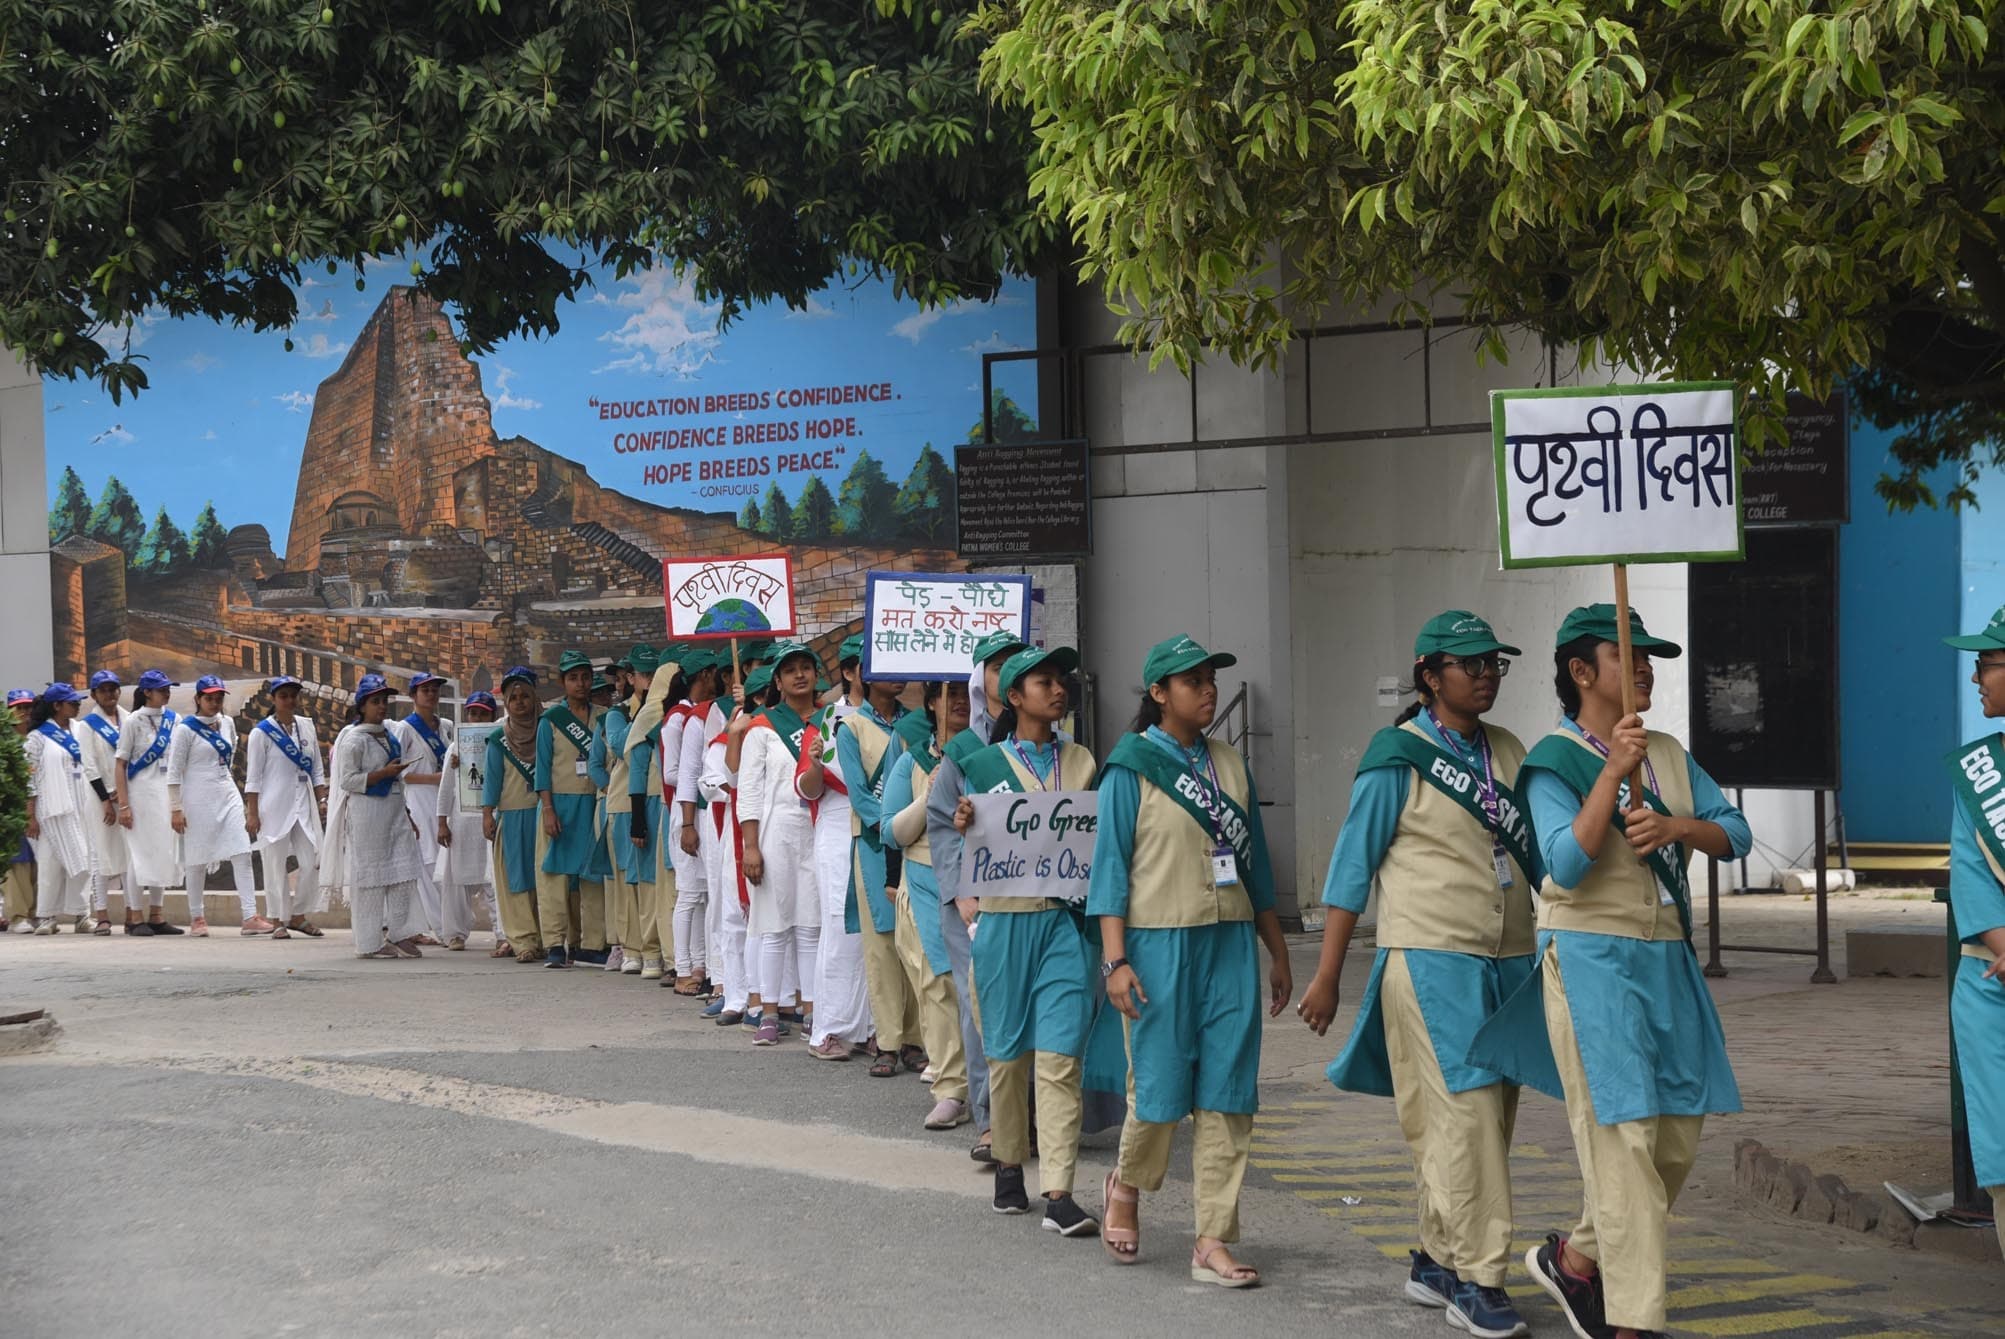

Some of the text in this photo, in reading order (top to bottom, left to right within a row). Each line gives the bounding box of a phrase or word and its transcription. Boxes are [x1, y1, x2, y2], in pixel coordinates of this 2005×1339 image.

[588, 394, 699, 420] "EDUCATION
[704, 392, 771, 414] BREEDS
[614, 417, 863, 454] CONFIDENCE BREEDS HOPE.
[643, 443, 845, 486] HOPE BREEDS PEACE."
[1505, 403, 1735, 526] पृथ्वी दिवस
[699, 484, 760, 498] CONFUCIUS
[1747, 505, 1789, 520] COLLEGE
[1004, 541, 1031, 552] COLLEGE
[673, 561, 785, 615] पृथ्वी दिवस
[881, 608, 917, 628] मत
[924, 604, 971, 630] करो
[566, 722, 586, 741] ECO
[1430, 756, 1471, 793] ECO
[1960, 744, 2002, 794] ECO
[1174, 772, 1212, 808] ECO
[1006, 798, 1098, 842] Go Gree
[972, 846, 1026, 883] Plastic
[1035, 855, 1051, 878] is
